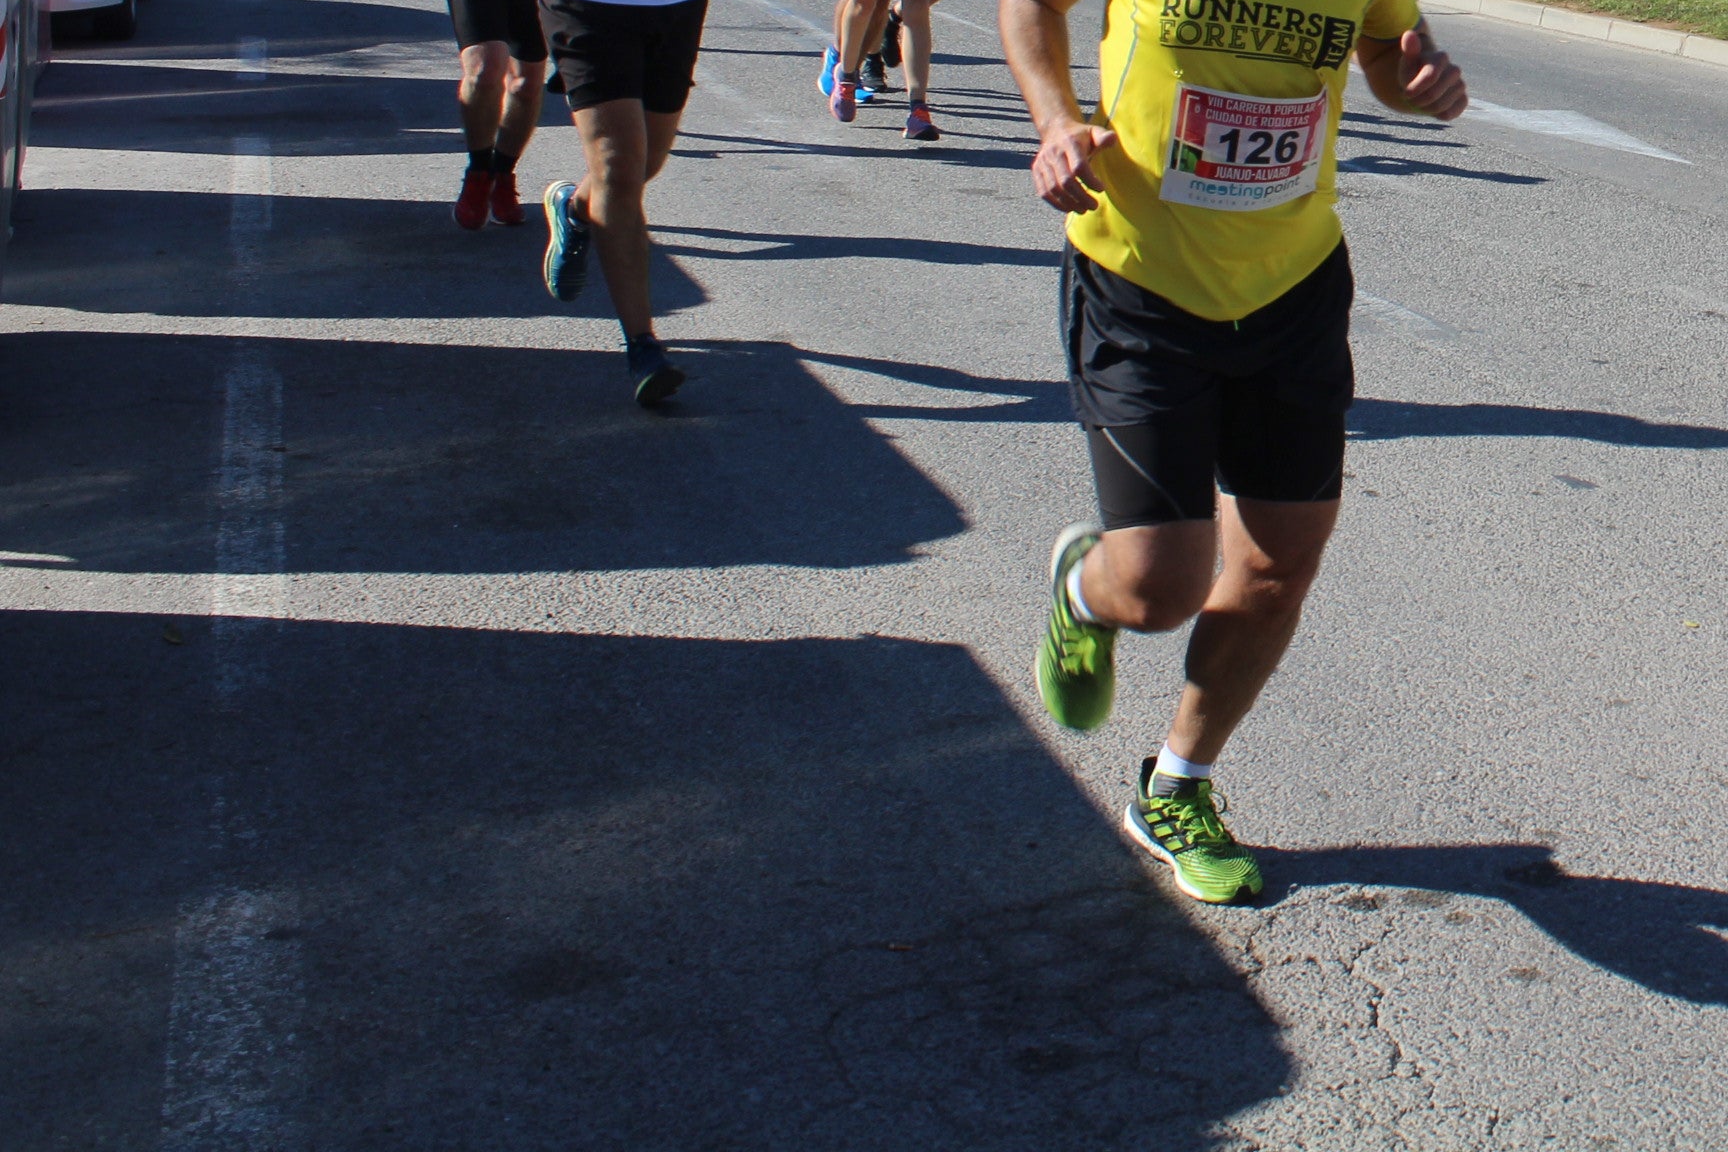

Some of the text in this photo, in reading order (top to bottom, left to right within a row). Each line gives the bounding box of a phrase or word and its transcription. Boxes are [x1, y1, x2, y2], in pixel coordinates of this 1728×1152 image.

[1159, 18, 1319, 63] FOREVER
[1325, 21, 1351, 64] TEAM
[1205, 109, 1310, 128] CIUDAD DE ROQUETAS
[1207, 95, 1316, 117] VIII CARRERA POPULAR
[1219, 127, 1300, 165] 126
[1215, 165, 1291, 182] JUANJO-ALVARO
[1189, 175, 1301, 200] meetingpoint
